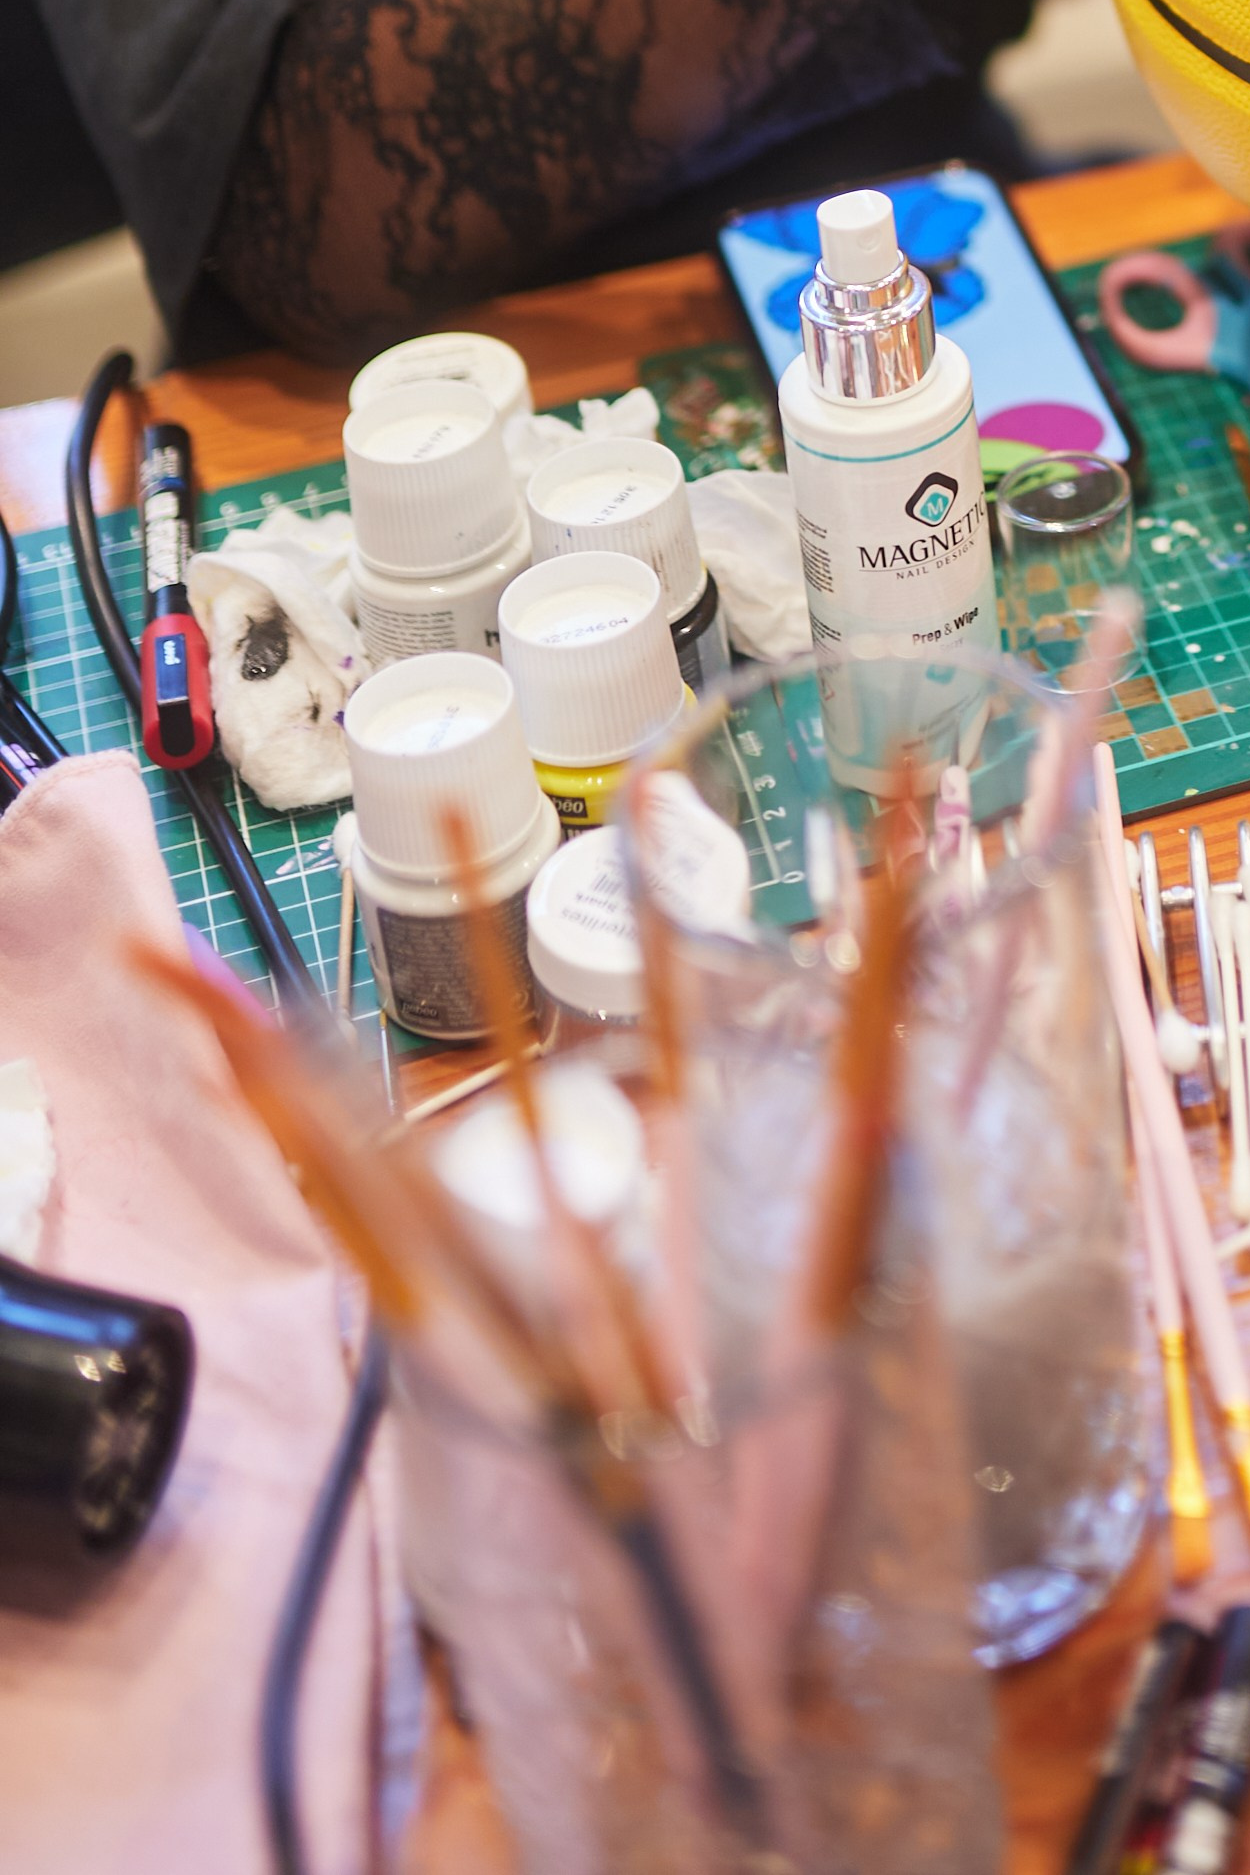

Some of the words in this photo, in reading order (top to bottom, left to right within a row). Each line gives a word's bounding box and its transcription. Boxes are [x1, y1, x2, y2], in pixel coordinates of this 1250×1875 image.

[926, 497, 945, 518] M
[896, 566, 929, 580] NAIL
[912, 629, 942, 646] Prep
[944, 623, 953, 636] &
[953, 607, 979, 629] Wipe
